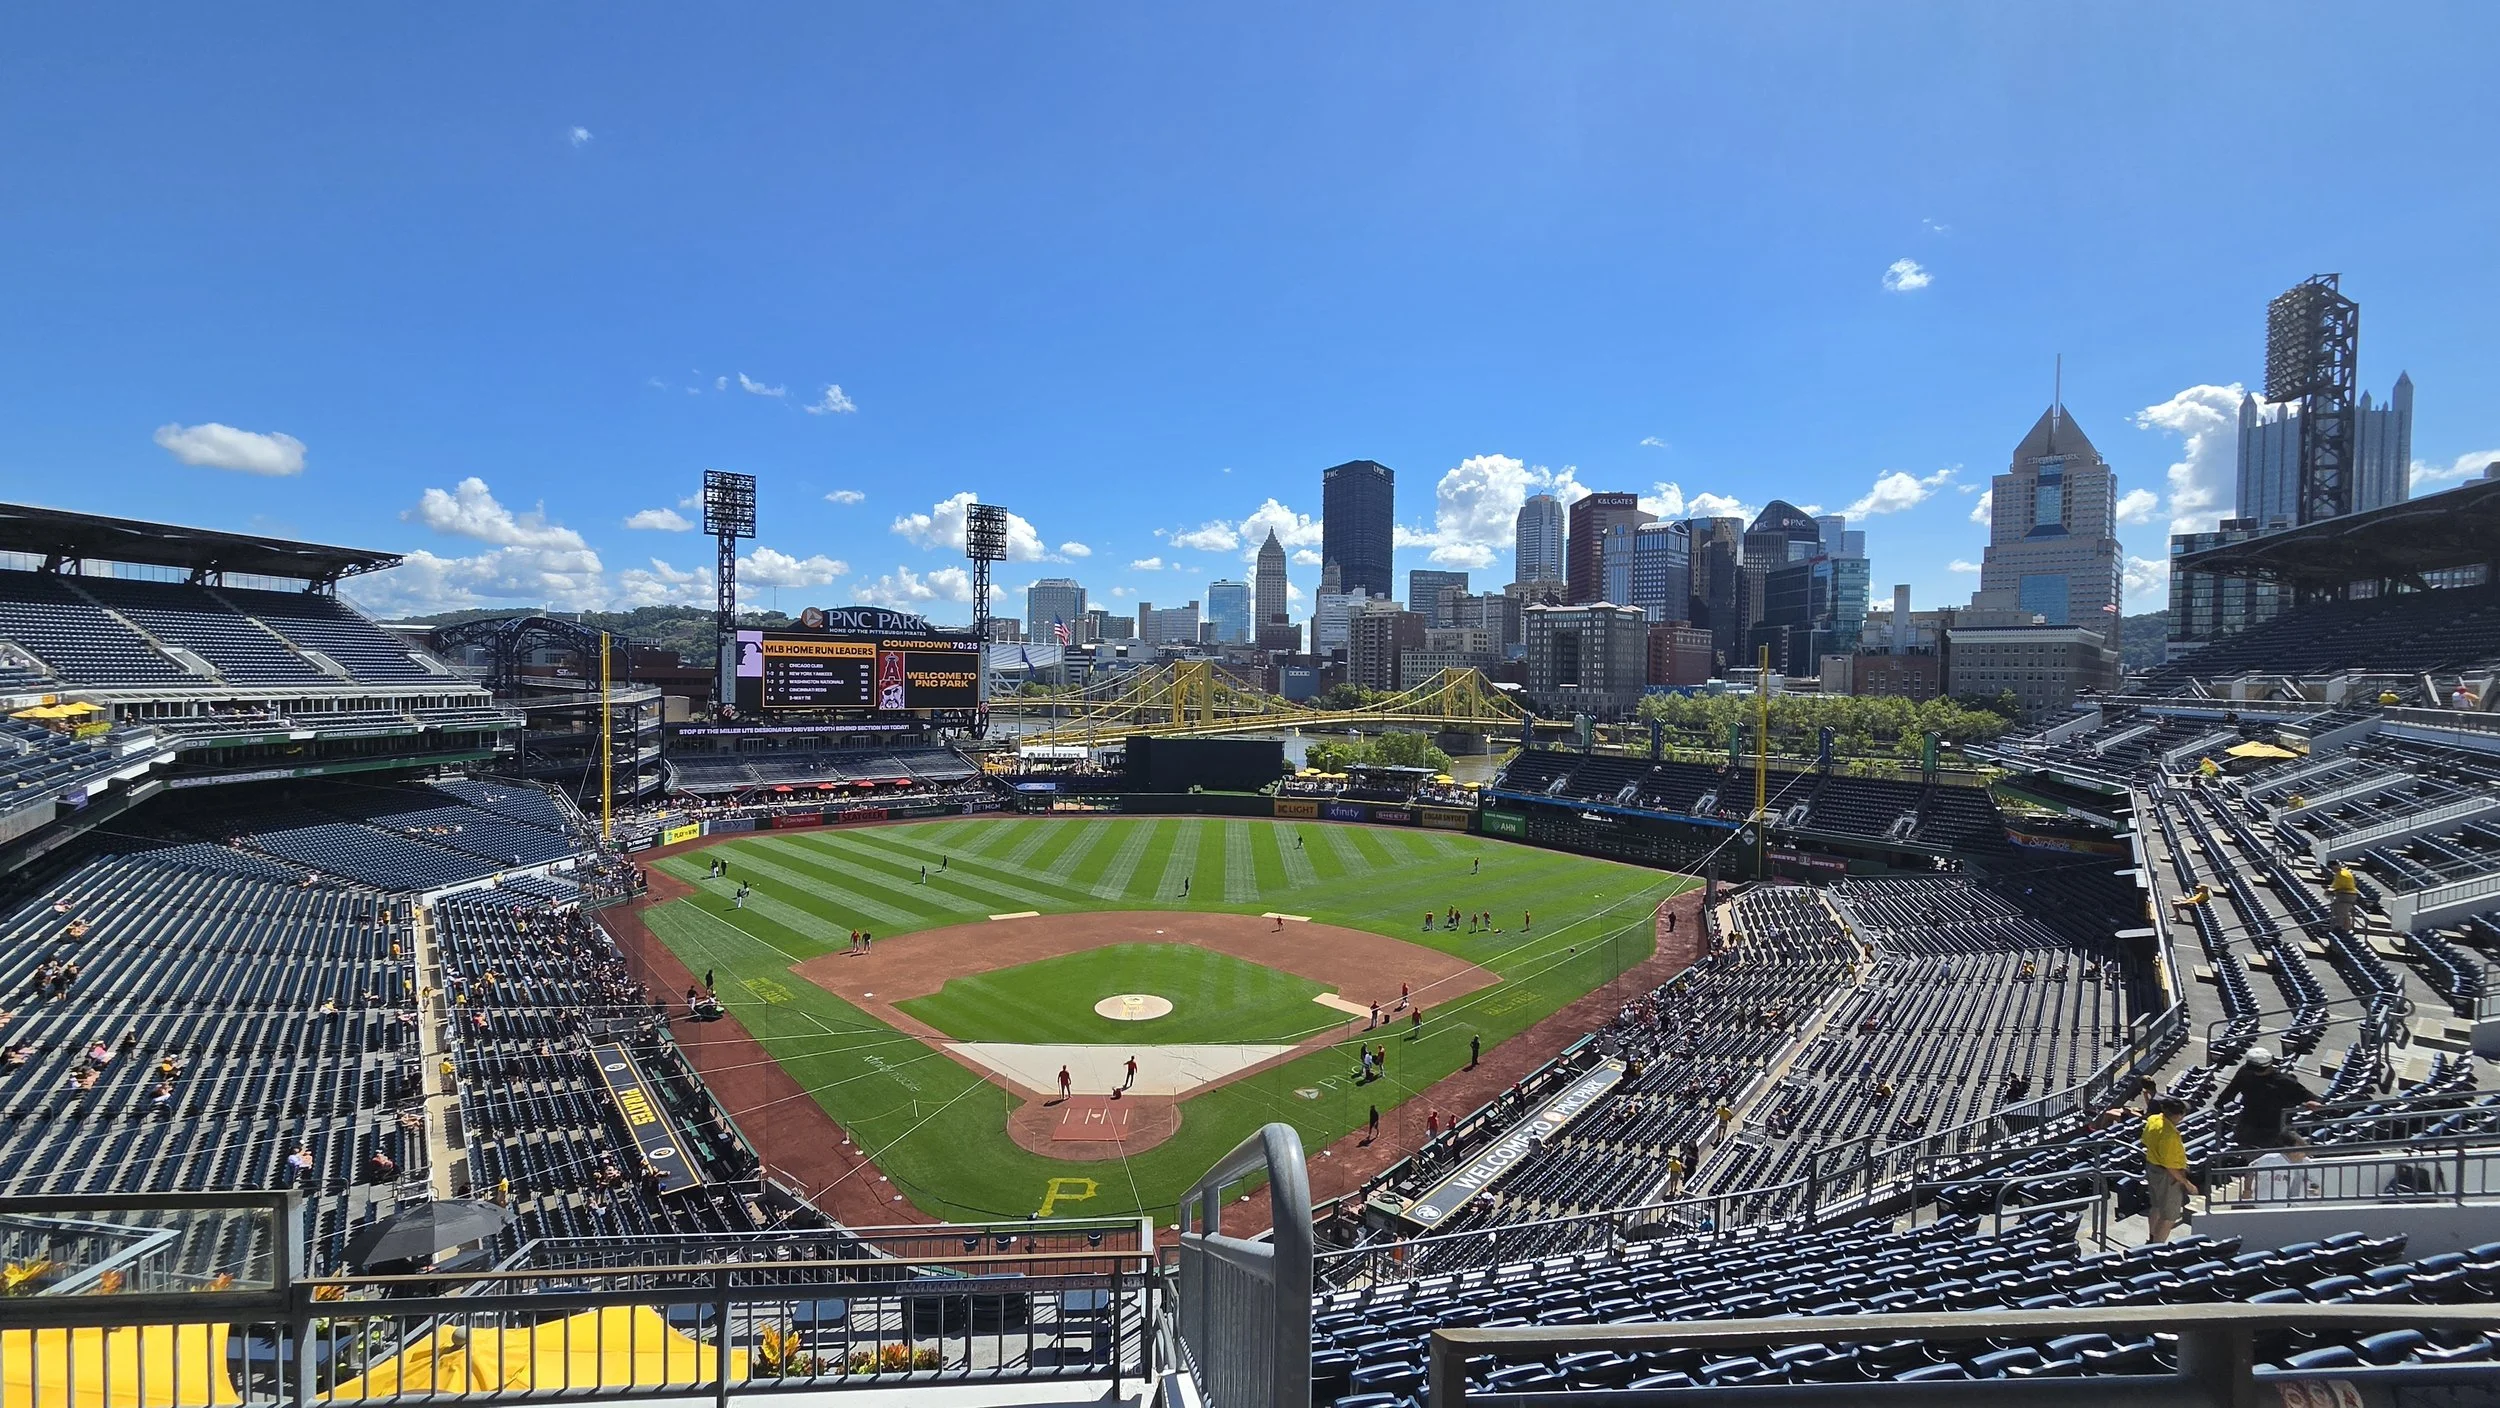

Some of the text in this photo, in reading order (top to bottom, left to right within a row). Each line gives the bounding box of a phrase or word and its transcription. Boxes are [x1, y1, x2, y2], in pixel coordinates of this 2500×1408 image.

[827, 610, 928, 630] PNC PARK
[765, 645, 874, 656] MLB HOME RUN LEADERS
[882, 640, 978, 650] COUNTDOWN 70:25
[907, 672, 961, 680] WELCOME
[940, 680, 969, 688] PARK
[170, 776, 211, 788] GAME
[211, 771, 279, 784] PRESENTED
[281, 770, 296, 778] BY
[1289, 806, 1314, 814] LIGHT
[1330, 806, 1359, 817] xfinity
[1442, 814, 1466, 822] SNYDER
[1501, 822, 1516, 832] AHN
[2029, 837, 2070, 850] Surfside
[618, 1088, 656, 1126] PIRATES
[1452, 1079, 1607, 1190] WELCOME TO PNC PARK
[1038, 1177, 1099, 1217] P
